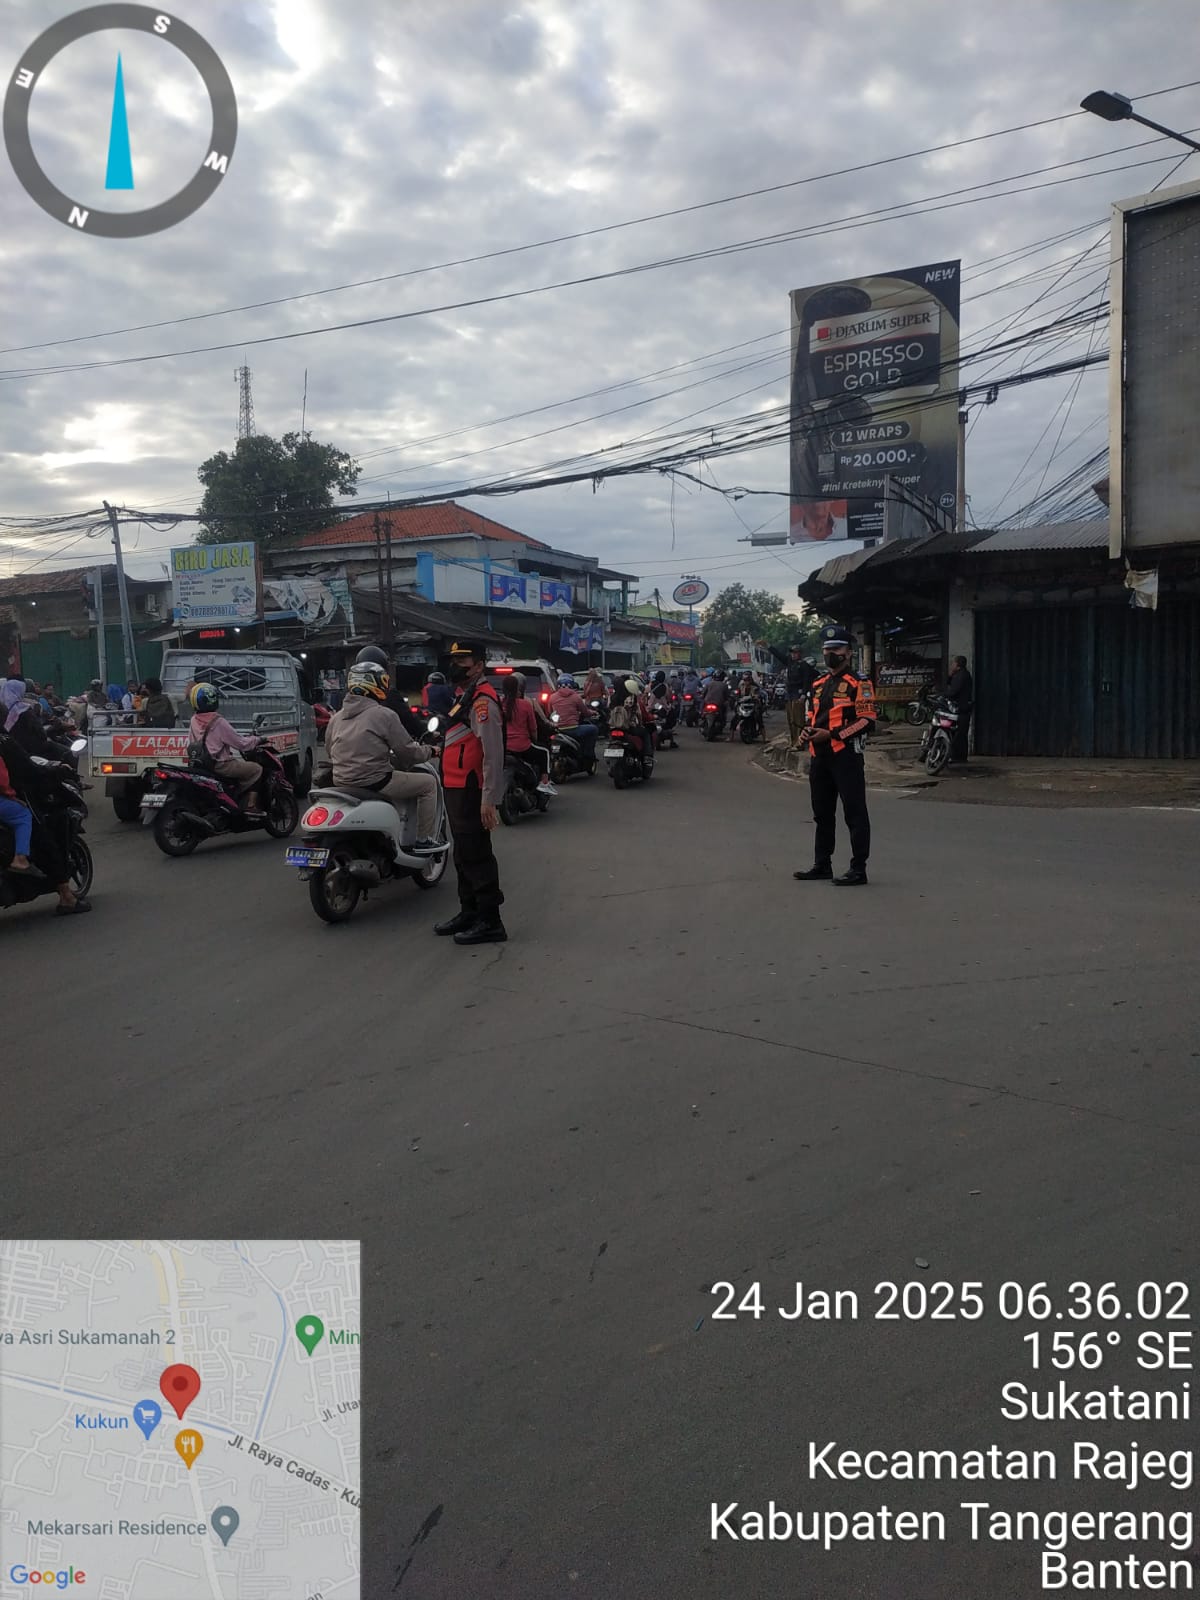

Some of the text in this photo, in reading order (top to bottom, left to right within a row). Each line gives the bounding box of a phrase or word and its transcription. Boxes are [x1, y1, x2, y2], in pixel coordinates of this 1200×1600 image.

[924, 267, 956, 283] NEW
[835, 312, 931, 340] DJARUM SUPER
[824, 342, 924, 374] ESPRESSO
[843, 367, 903, 391] GOLD
[841, 425, 902, 443] 12 WRAPS
[175, 546, 251, 571] BIRO JASA
